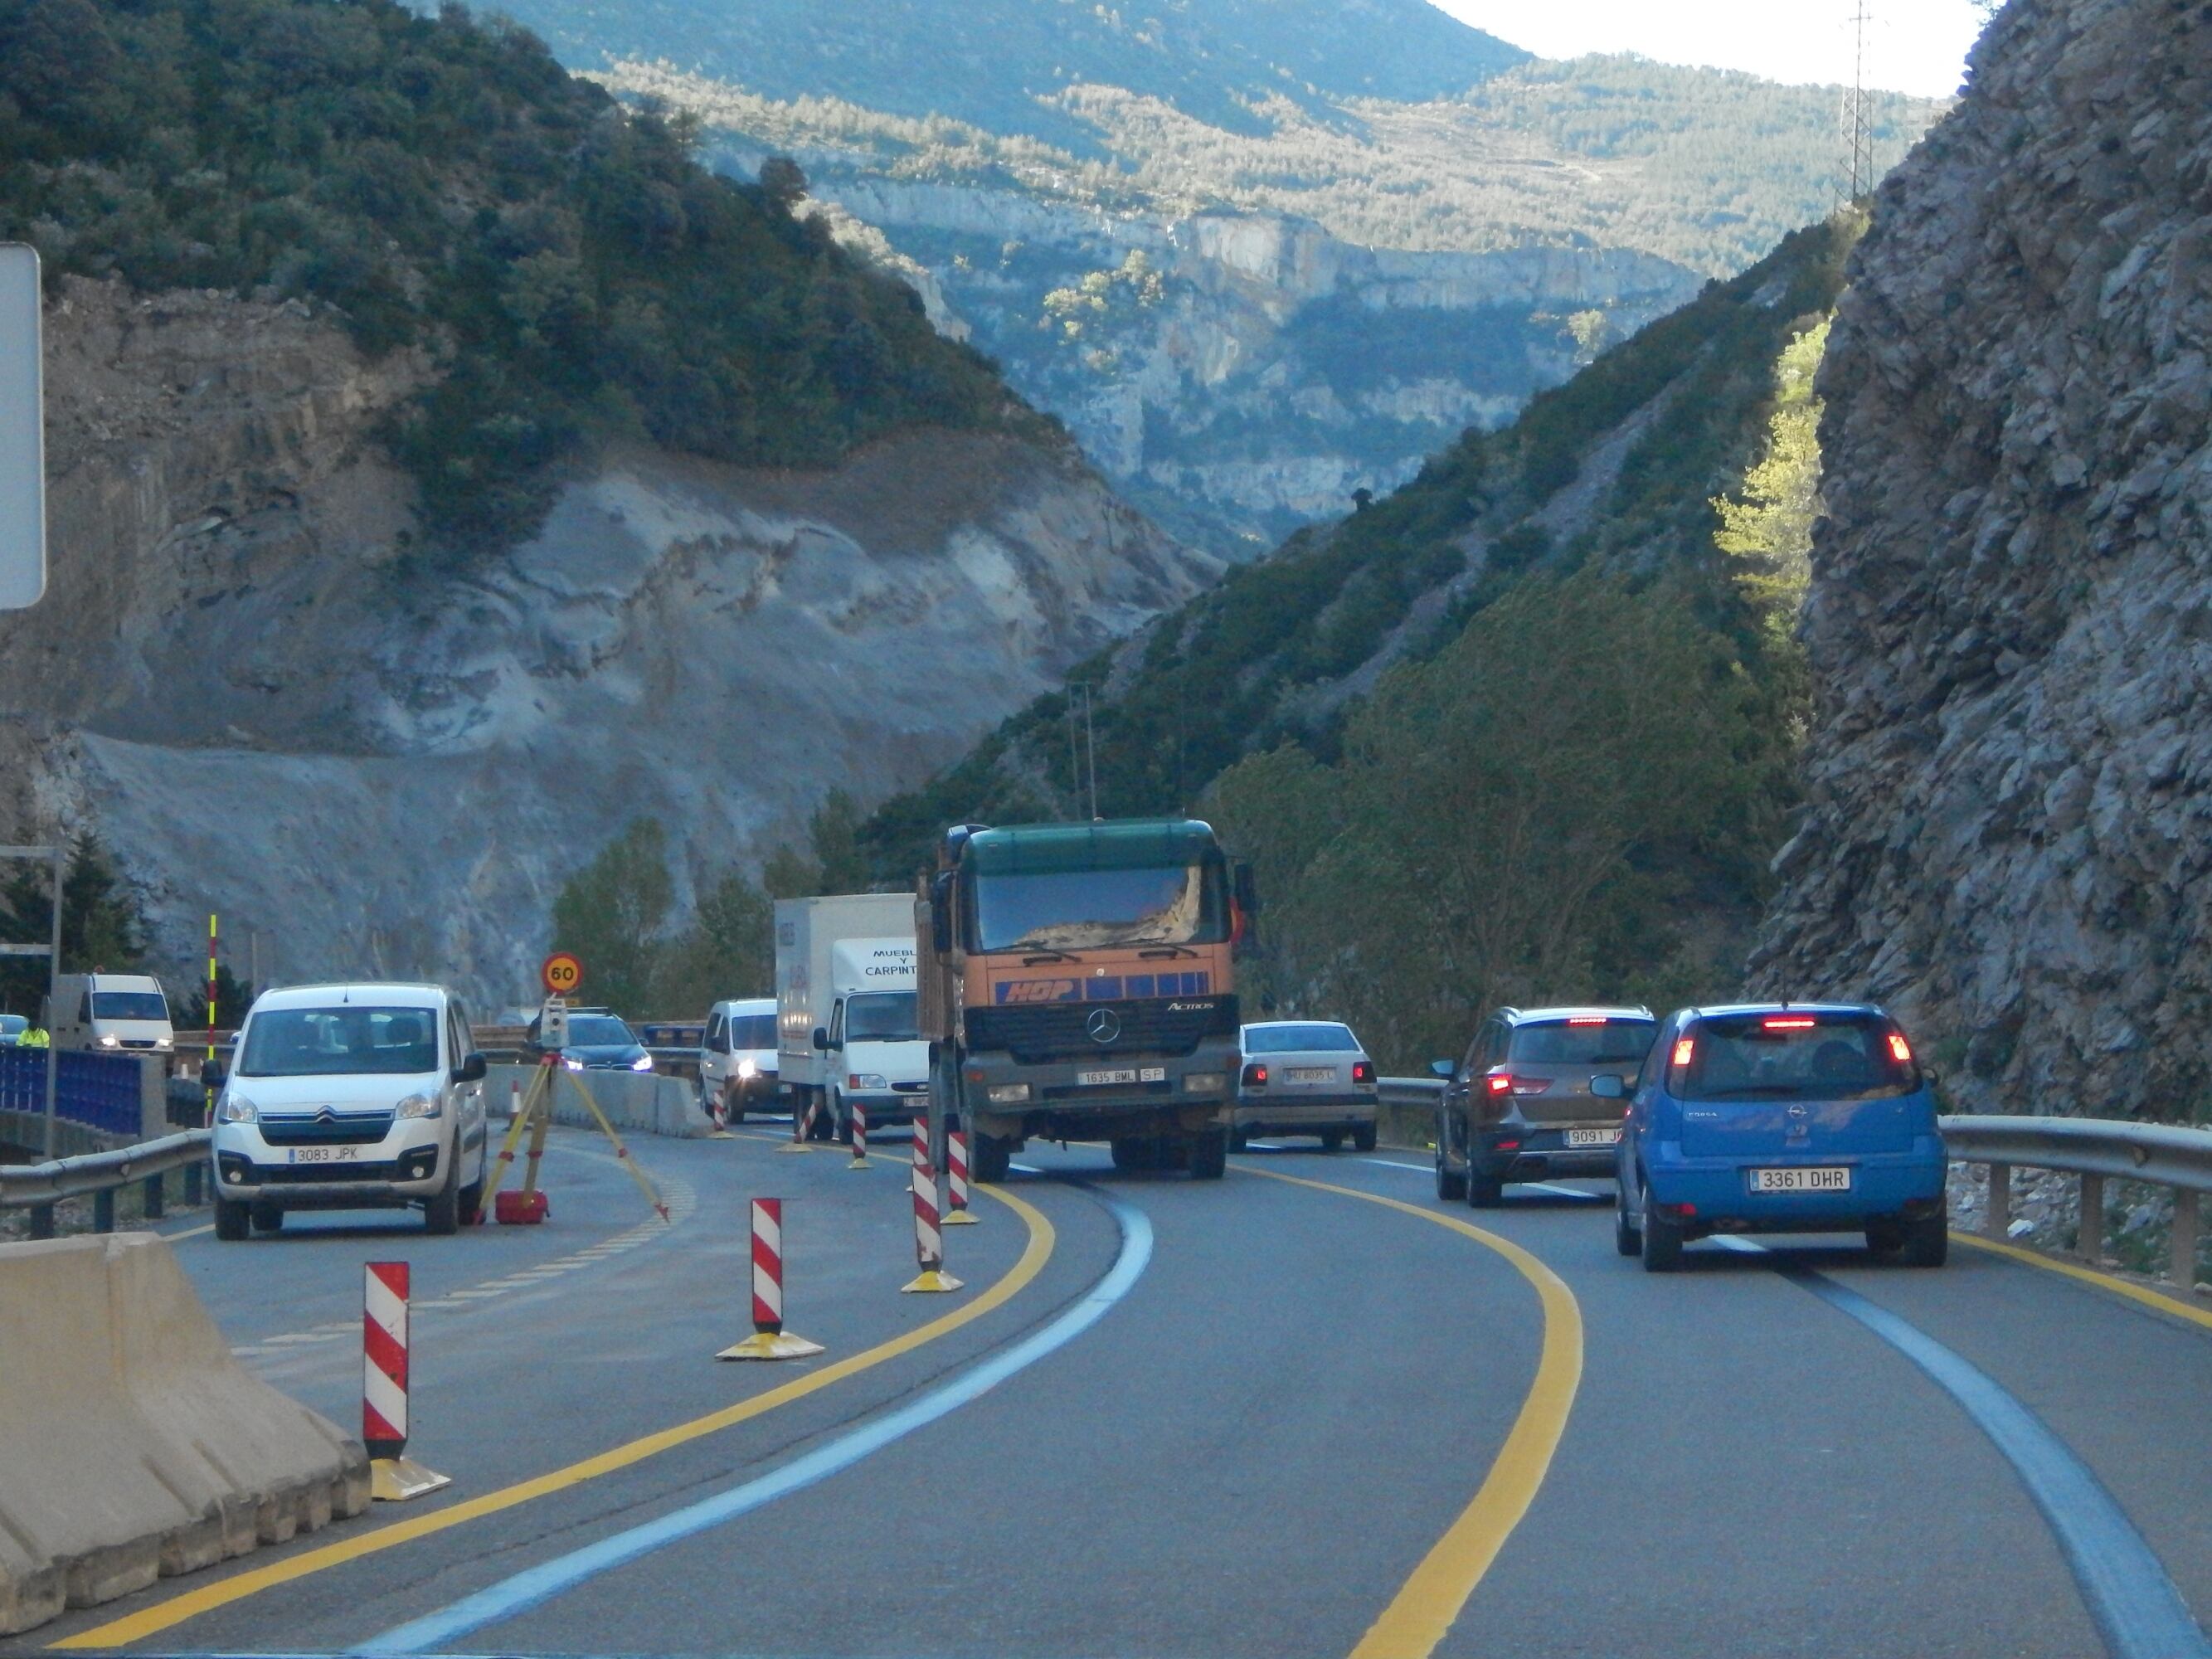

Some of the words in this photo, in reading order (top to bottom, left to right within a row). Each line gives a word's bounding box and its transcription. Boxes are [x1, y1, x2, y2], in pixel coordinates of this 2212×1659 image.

[552, 967, 574, 980] 60
[865, 966, 916, 975] CARPINT
[1005, 980, 1073, 1002] HOP
[1087, 1073, 1110, 1083] 1635
[1573, 1131, 1603, 1142] 9091
[299, 1149, 328, 1161] 3083
[335, 1147, 357, 1160] JPK
[1763, 1172, 1802, 1188] 3361
[1811, 1171, 1844, 1187] DHR
